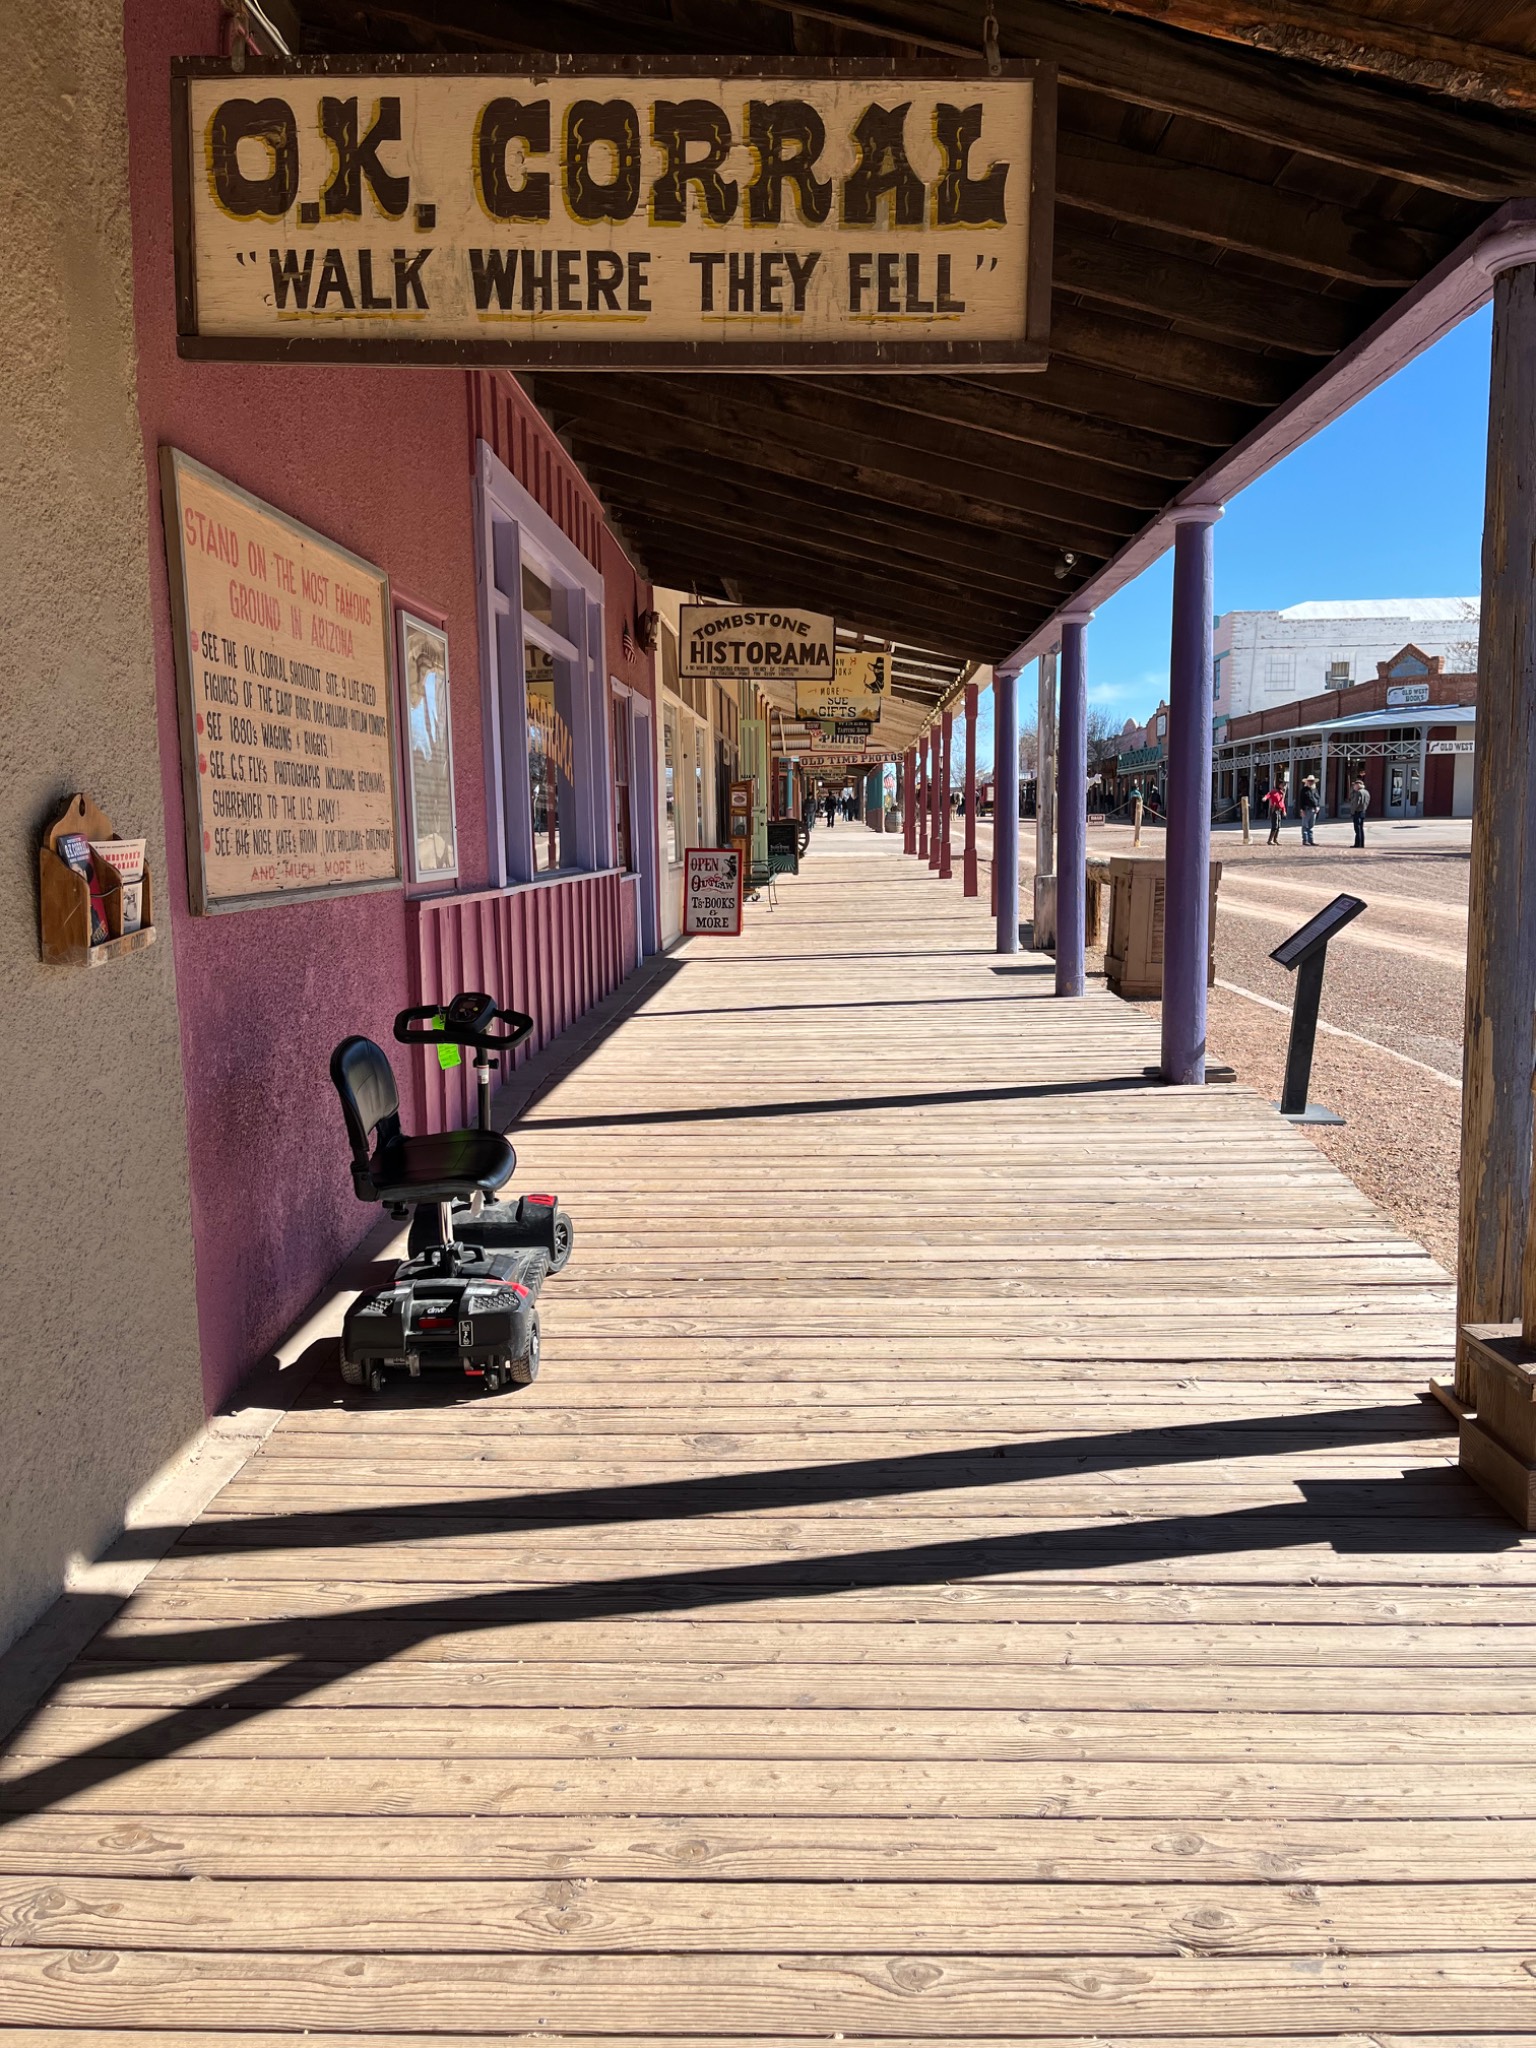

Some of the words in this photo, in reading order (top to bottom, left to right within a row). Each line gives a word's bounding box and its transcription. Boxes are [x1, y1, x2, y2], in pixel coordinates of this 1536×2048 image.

[204, 96, 436, 232] O.K.
[471, 96, 1010, 231] CORRAL
[468, 248, 652, 313] WHERE
[689, 251, 821, 312] THEY
[184, 507, 239, 568] STAND
[249, 540, 267, 582] ON
[273, 552, 296, 595] THE
[301, 566, 329, 610] MOST
[334, 582, 372, 627] FAMOUS
[229, 579, 281, 632] GROUND
[290, 604, 302, 641] IN
[311, 614, 355, 660] ARIZONA
[692, 612, 811, 641] TOMBSTONE
[690, 641, 831, 666] HISTORAMA
[201, 631, 220, 663] SEE
[220, 638, 238, 669] THE
[243, 644, 259, 677] O.K.
[259, 650, 288, 684] CORRAL
[289, 660, 321, 693] SHOOTOUT
[342, 676, 347, 699] 9
[348, 678, 360, 703] LIFE
[360, 682, 376, 707] SIZED
[203, 671, 239, 707] FIGURES
[243, 680, 253, 709] OF
[257, 684, 274, 715] THE
[275, 689, 293, 718] EARP
[312, 699, 325, 726] DOC
[820, 687, 840, 695] MORE
[819, 707, 857, 717] GIFTS
[206, 710, 223, 742] SEE
[229, 715, 258, 747] 1880's
[261, 722, 292, 752] WAGONS
[821, 734, 865, 744] PHOTOS
[801, 757, 825, 766] OLD
[826, 755, 858, 764] TIME
[861, 752, 903, 763] PHOTOS
[1440, 743, 1454, 751] OLD
[1454, 742, 1474, 751] WEST
[209, 750, 226, 780] SEE
[230, 754, 245, 783] C.S.
[273, 760, 321, 789] PHOTOGRAPHS
[324, 766, 355, 792] INCLUDING
[212, 789, 263, 820] SURRENDER
[267, 794, 278, 820] TO
[281, 795, 296, 820] THE
[300, 796, 314, 821] U.S.
[214, 827, 231, 857] SEE
[235, 828, 250, 857] BIG
[253, 829, 272, 856] NOSE
[299, 829, 318, 854] ROOM
[251, 864, 276, 882] AND
[284, 862, 316, 880] MUCH
[324, 860, 352, 877] MORE
[691, 857, 719, 871] OPEN
[704, 897, 735, 909] BOOKS
[696, 917, 729, 928] MORE
